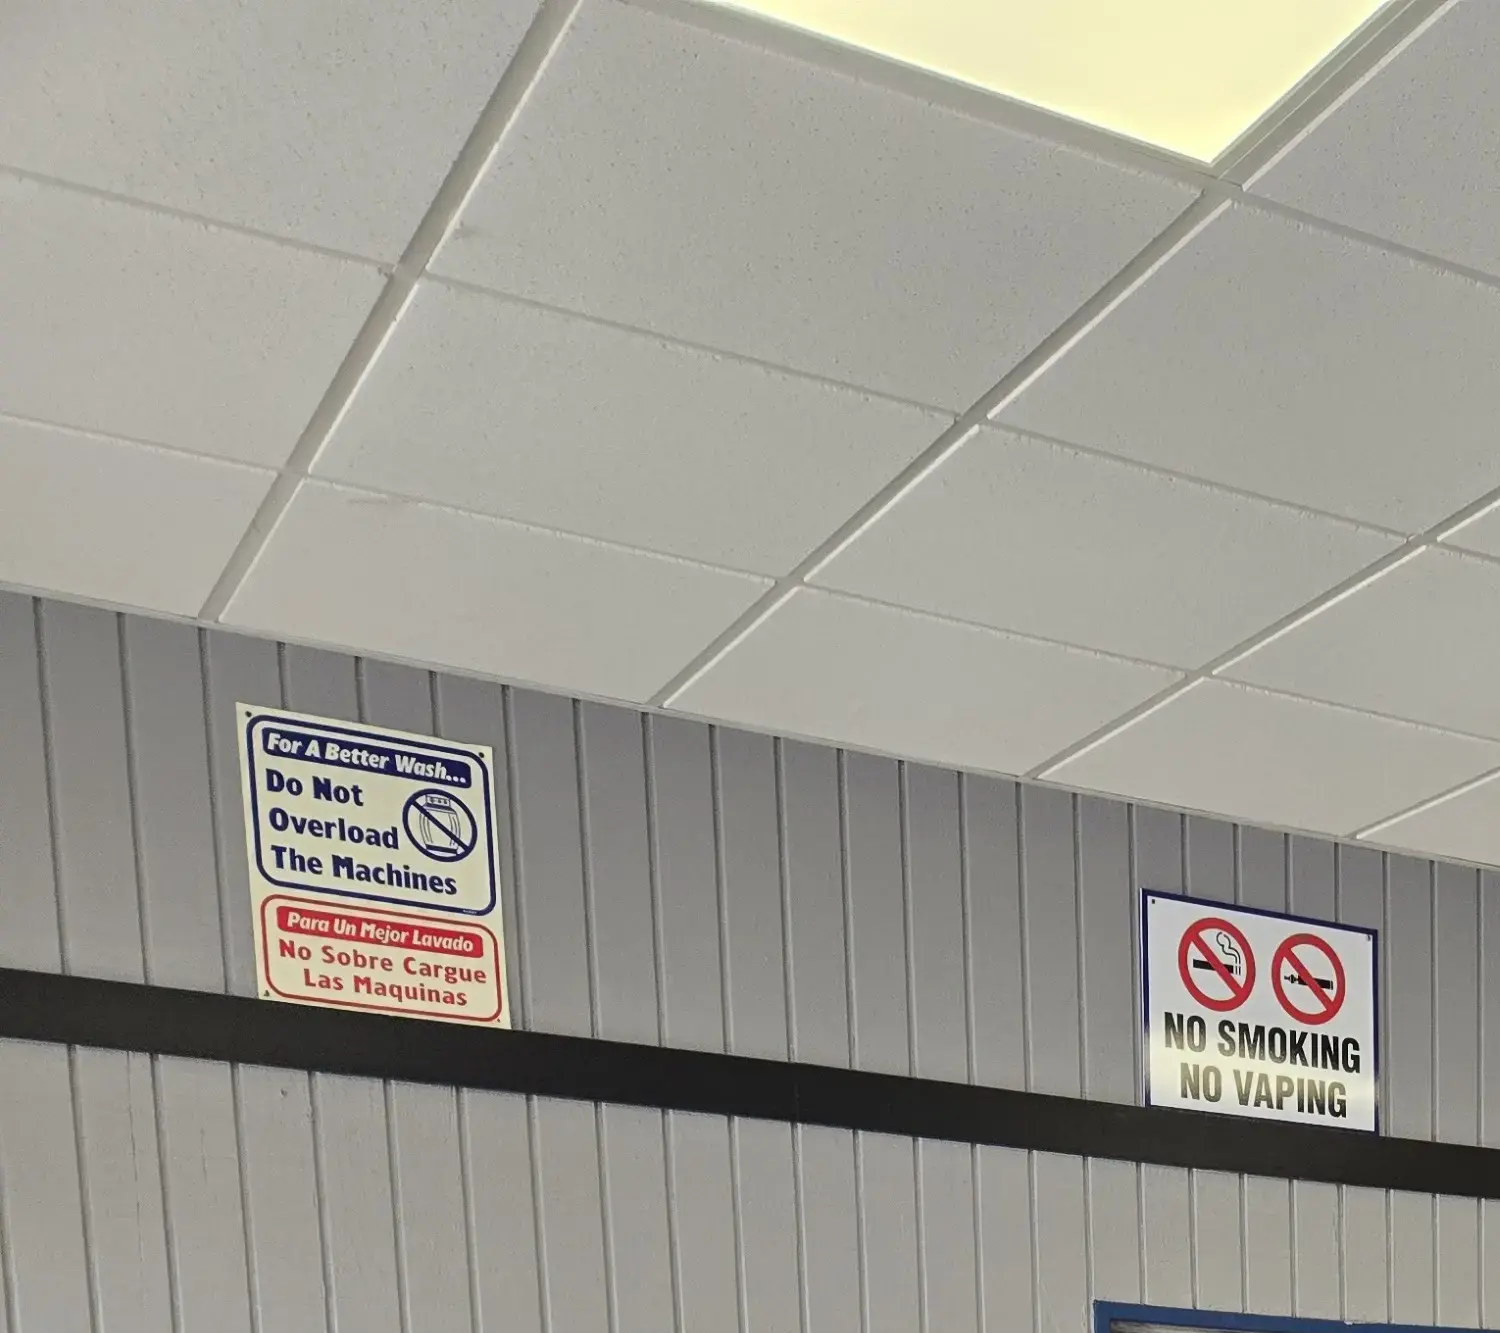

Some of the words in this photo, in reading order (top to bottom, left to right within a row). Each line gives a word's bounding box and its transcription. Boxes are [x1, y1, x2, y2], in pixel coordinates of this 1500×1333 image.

[267, 732, 303, 755] For
[305, 740, 321, 758] A
[325, 744, 390, 770] Better
[395, 754, 467, 784] Wash...
[265, 768, 303, 796] Do
[312, 775, 364, 807] Not
[268, 807, 400, 850] Overload
[270, 845, 323, 875] The
[331, 855, 458, 895] Machines
[286, 911, 330, 934] Para
[333, 917, 357, 937] Un
[359, 922, 409, 946] Mejor
[412, 929, 475, 953] Lavado
[279, 938, 312, 962] No
[321, 945, 394, 972] Sobre
[403, 956, 487, 985] Cargue
[303, 968, 345, 991] Las
[353, 975, 468, 1008] Maquinas
[1164, 1011, 1207, 1053] NO
[1217, 1019, 1361, 1074] SMOKING
[1180, 1062, 1223, 1103] NO
[1233, 1068, 1347, 1119] VAPING
